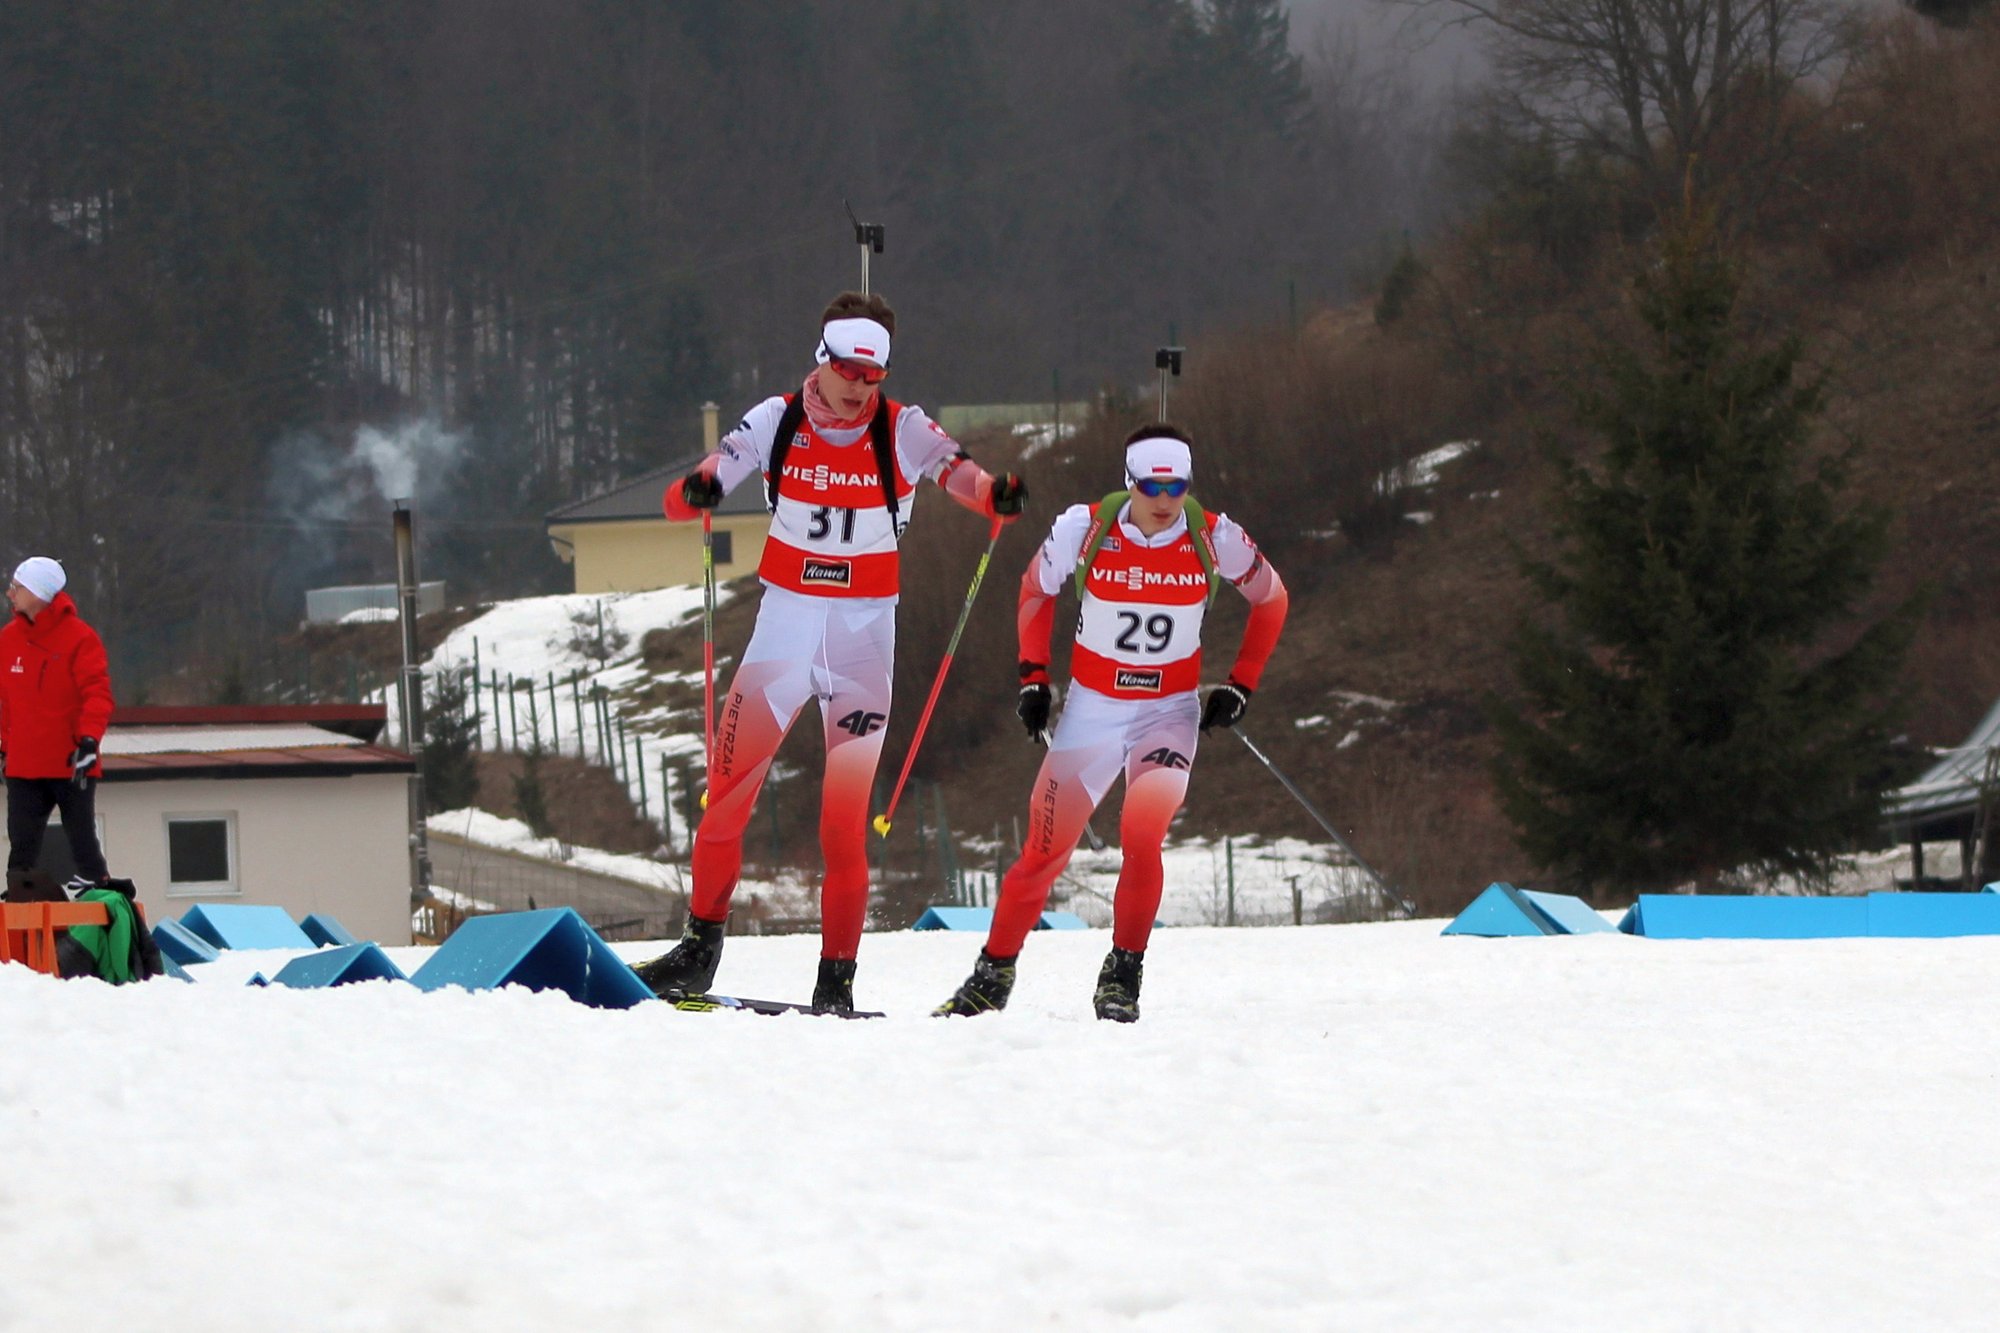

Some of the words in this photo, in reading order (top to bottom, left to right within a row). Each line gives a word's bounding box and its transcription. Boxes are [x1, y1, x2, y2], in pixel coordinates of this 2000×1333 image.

[782, 464, 882, 491] VIESSMAN
[807, 505, 858, 544] 31
[1091, 566, 1207, 590] VIESSMANN
[1115, 611, 1174, 653] 29
[721, 692, 743, 779] PIETRZAK
[837, 710, 886, 737] 4F
[1141, 747, 1190, 768] 4F
[1039, 778, 1059, 856] PIETRZAK
